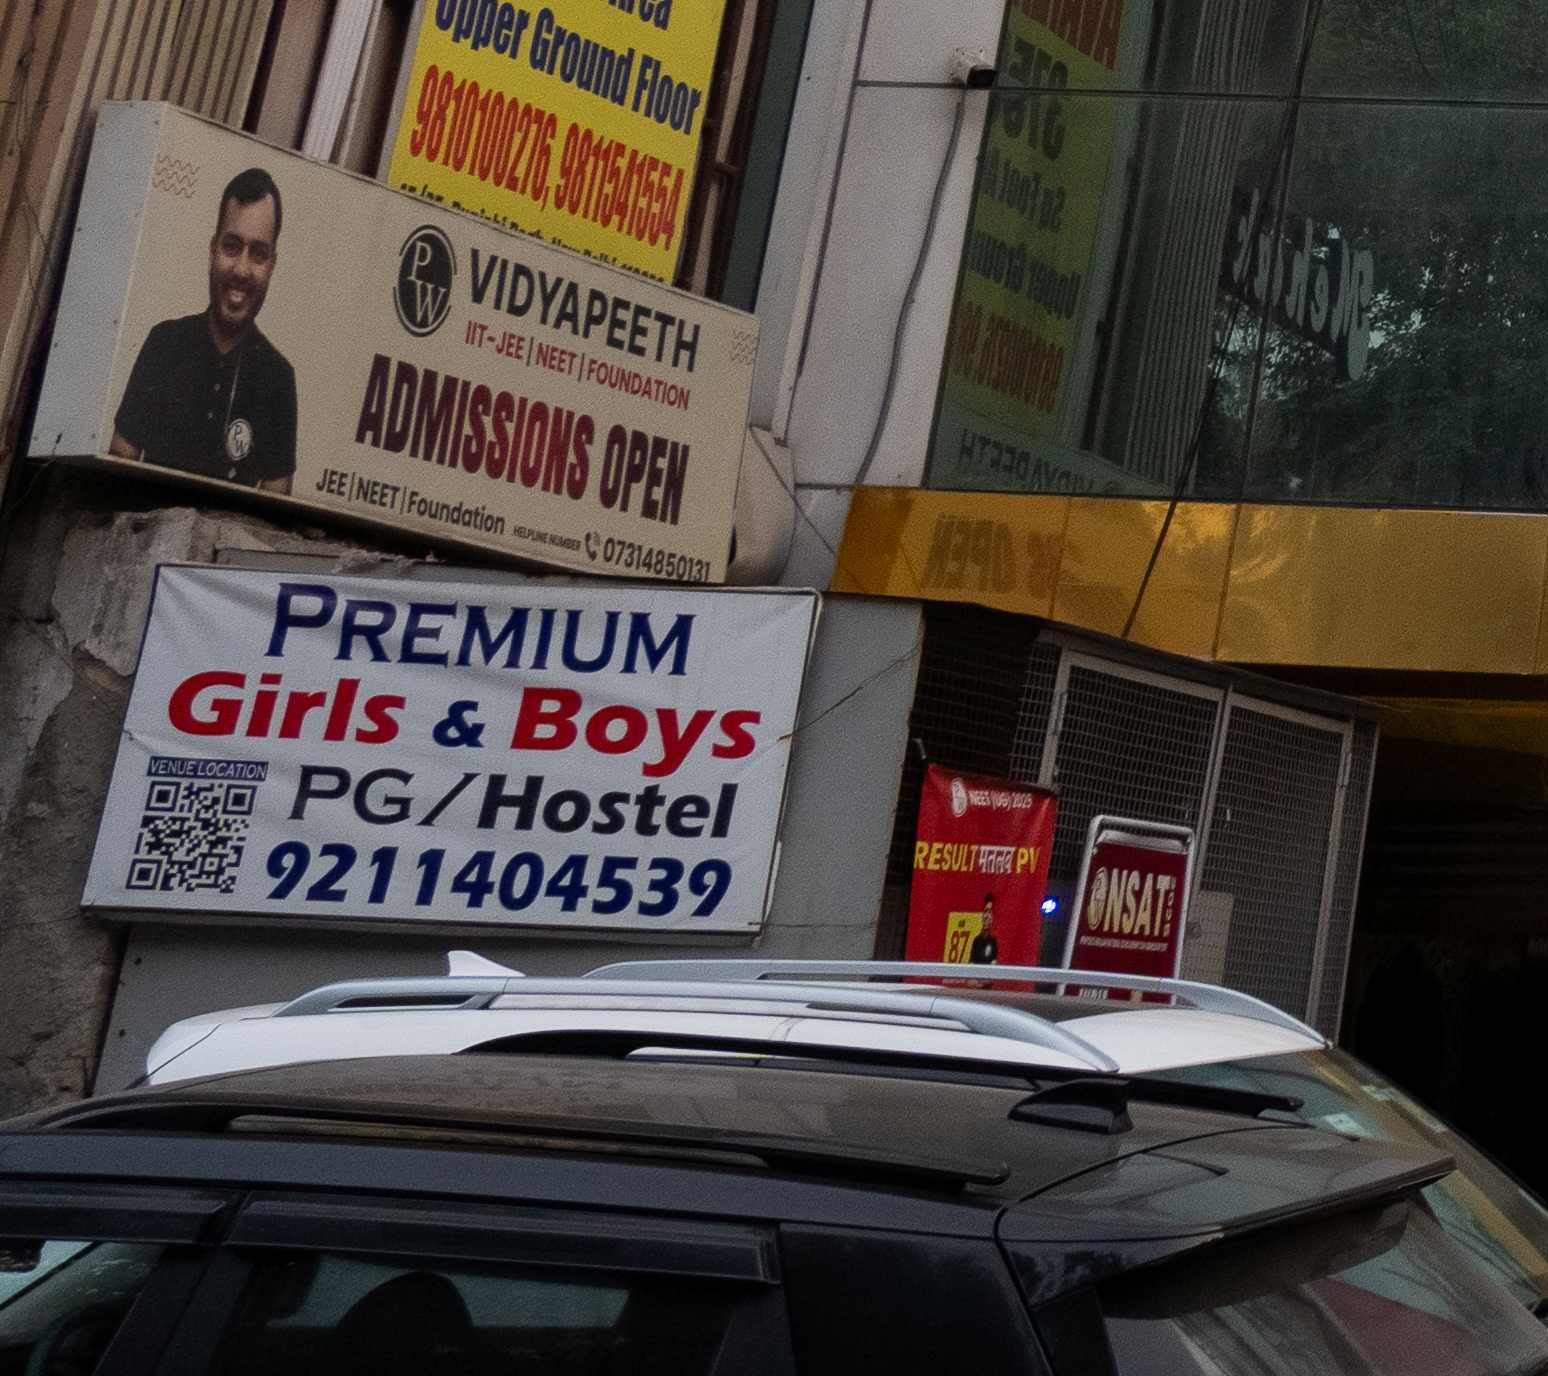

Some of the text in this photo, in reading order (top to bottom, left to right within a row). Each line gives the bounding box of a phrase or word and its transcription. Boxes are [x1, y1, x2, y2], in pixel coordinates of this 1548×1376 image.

[530, 7, 636, 106] Ground
[631, 53, 703, 137] Floor
[554, 122, 685, 251] 9811541554
[469, 248, 701, 373] VIDYAPEETH
[465, 320, 524, 359] IIT-JEE
[535, 341, 576, 377] NEET
[587, 354, 691, 412] FOUNDATION
[355, 354, 595, 502] ADMISSIONS
[599, 424, 691, 527] OPEN
[315, 468, 347, 499] JEE
[355, 474, 401, 513] NEET
[407, 491, 507, 536] Foundation
[603, 537, 711, 583] 07314850131
[264, 582, 697, 677] PREMIUM
[150, 758, 269, 780] VENUE LOCATION
[167, 670, 762, 778] Girls & Boys
[265, 841, 733, 918] 9211404539
[913, 841, 978, 872] RESULT
